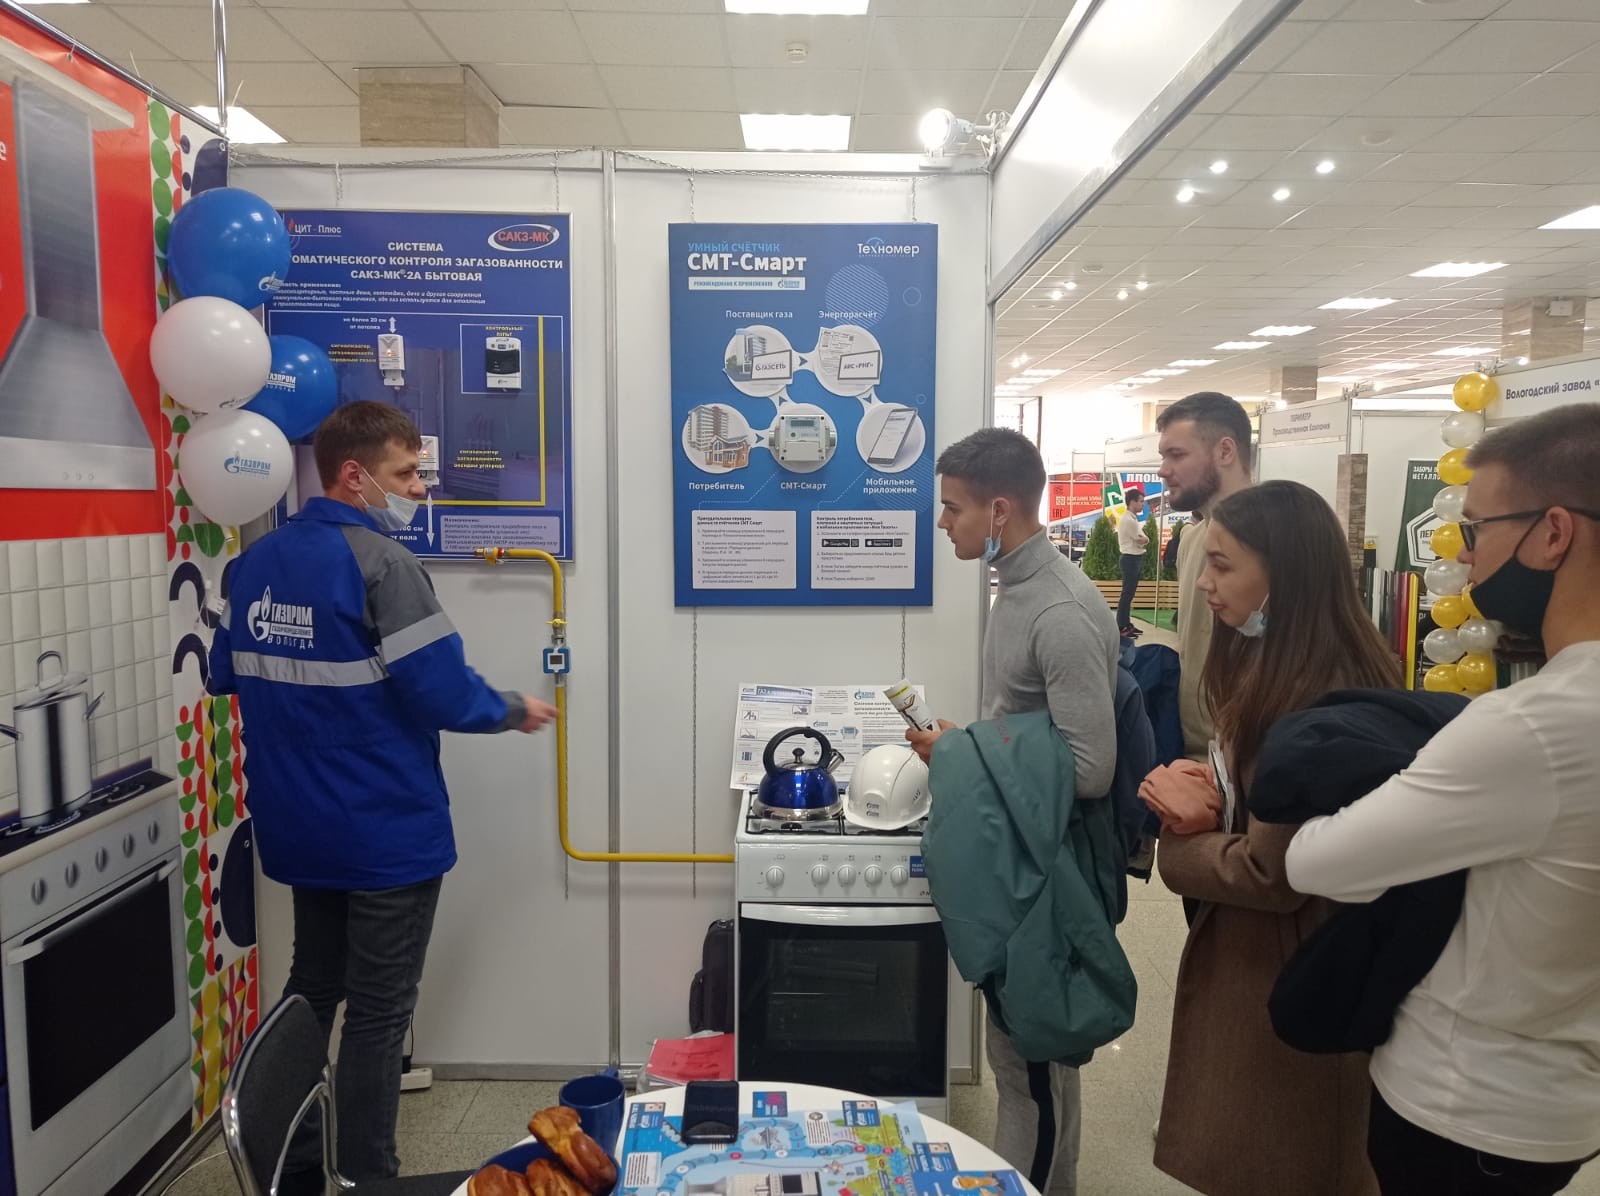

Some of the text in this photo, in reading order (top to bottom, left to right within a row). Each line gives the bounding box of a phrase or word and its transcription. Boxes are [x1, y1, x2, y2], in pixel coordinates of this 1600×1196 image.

[295, 224, 312, 234] ЦИТ
[318, 224, 342, 234] Плюс
[387, 242, 444, 252] СИСТЕМА
[688, 240, 781, 252] УМНЫЙ СЧЁТЧИК
[856, 242, 920, 258] Техномер
[289, 254, 563, 269] ОМАТИЧЕСКОГО КОНТРОЛЯ ЗАГАЗОВАННОСТИ
[687, 252, 807, 275] СМТ-Смарт
[425, 271, 483, 282] БЫТОВАЯ
[725, 310, 774, 321] Поставщик
[818, 310, 878, 322] Энергорасчёт
[269, 373, 297, 384] АЗПРОМ
[1506, 379, 1592, 400] Вологодский завод
[688, 482, 745, 491] Потребитель
[780, 482, 827, 491] СМТ-Смарт
[866, 477, 915, 486] Мобильное
[863, 485, 917, 495] приложение
[271, 603, 313, 626] ГАЗПРОМ
[267, 634, 314, 650] ВОЛОГДА
